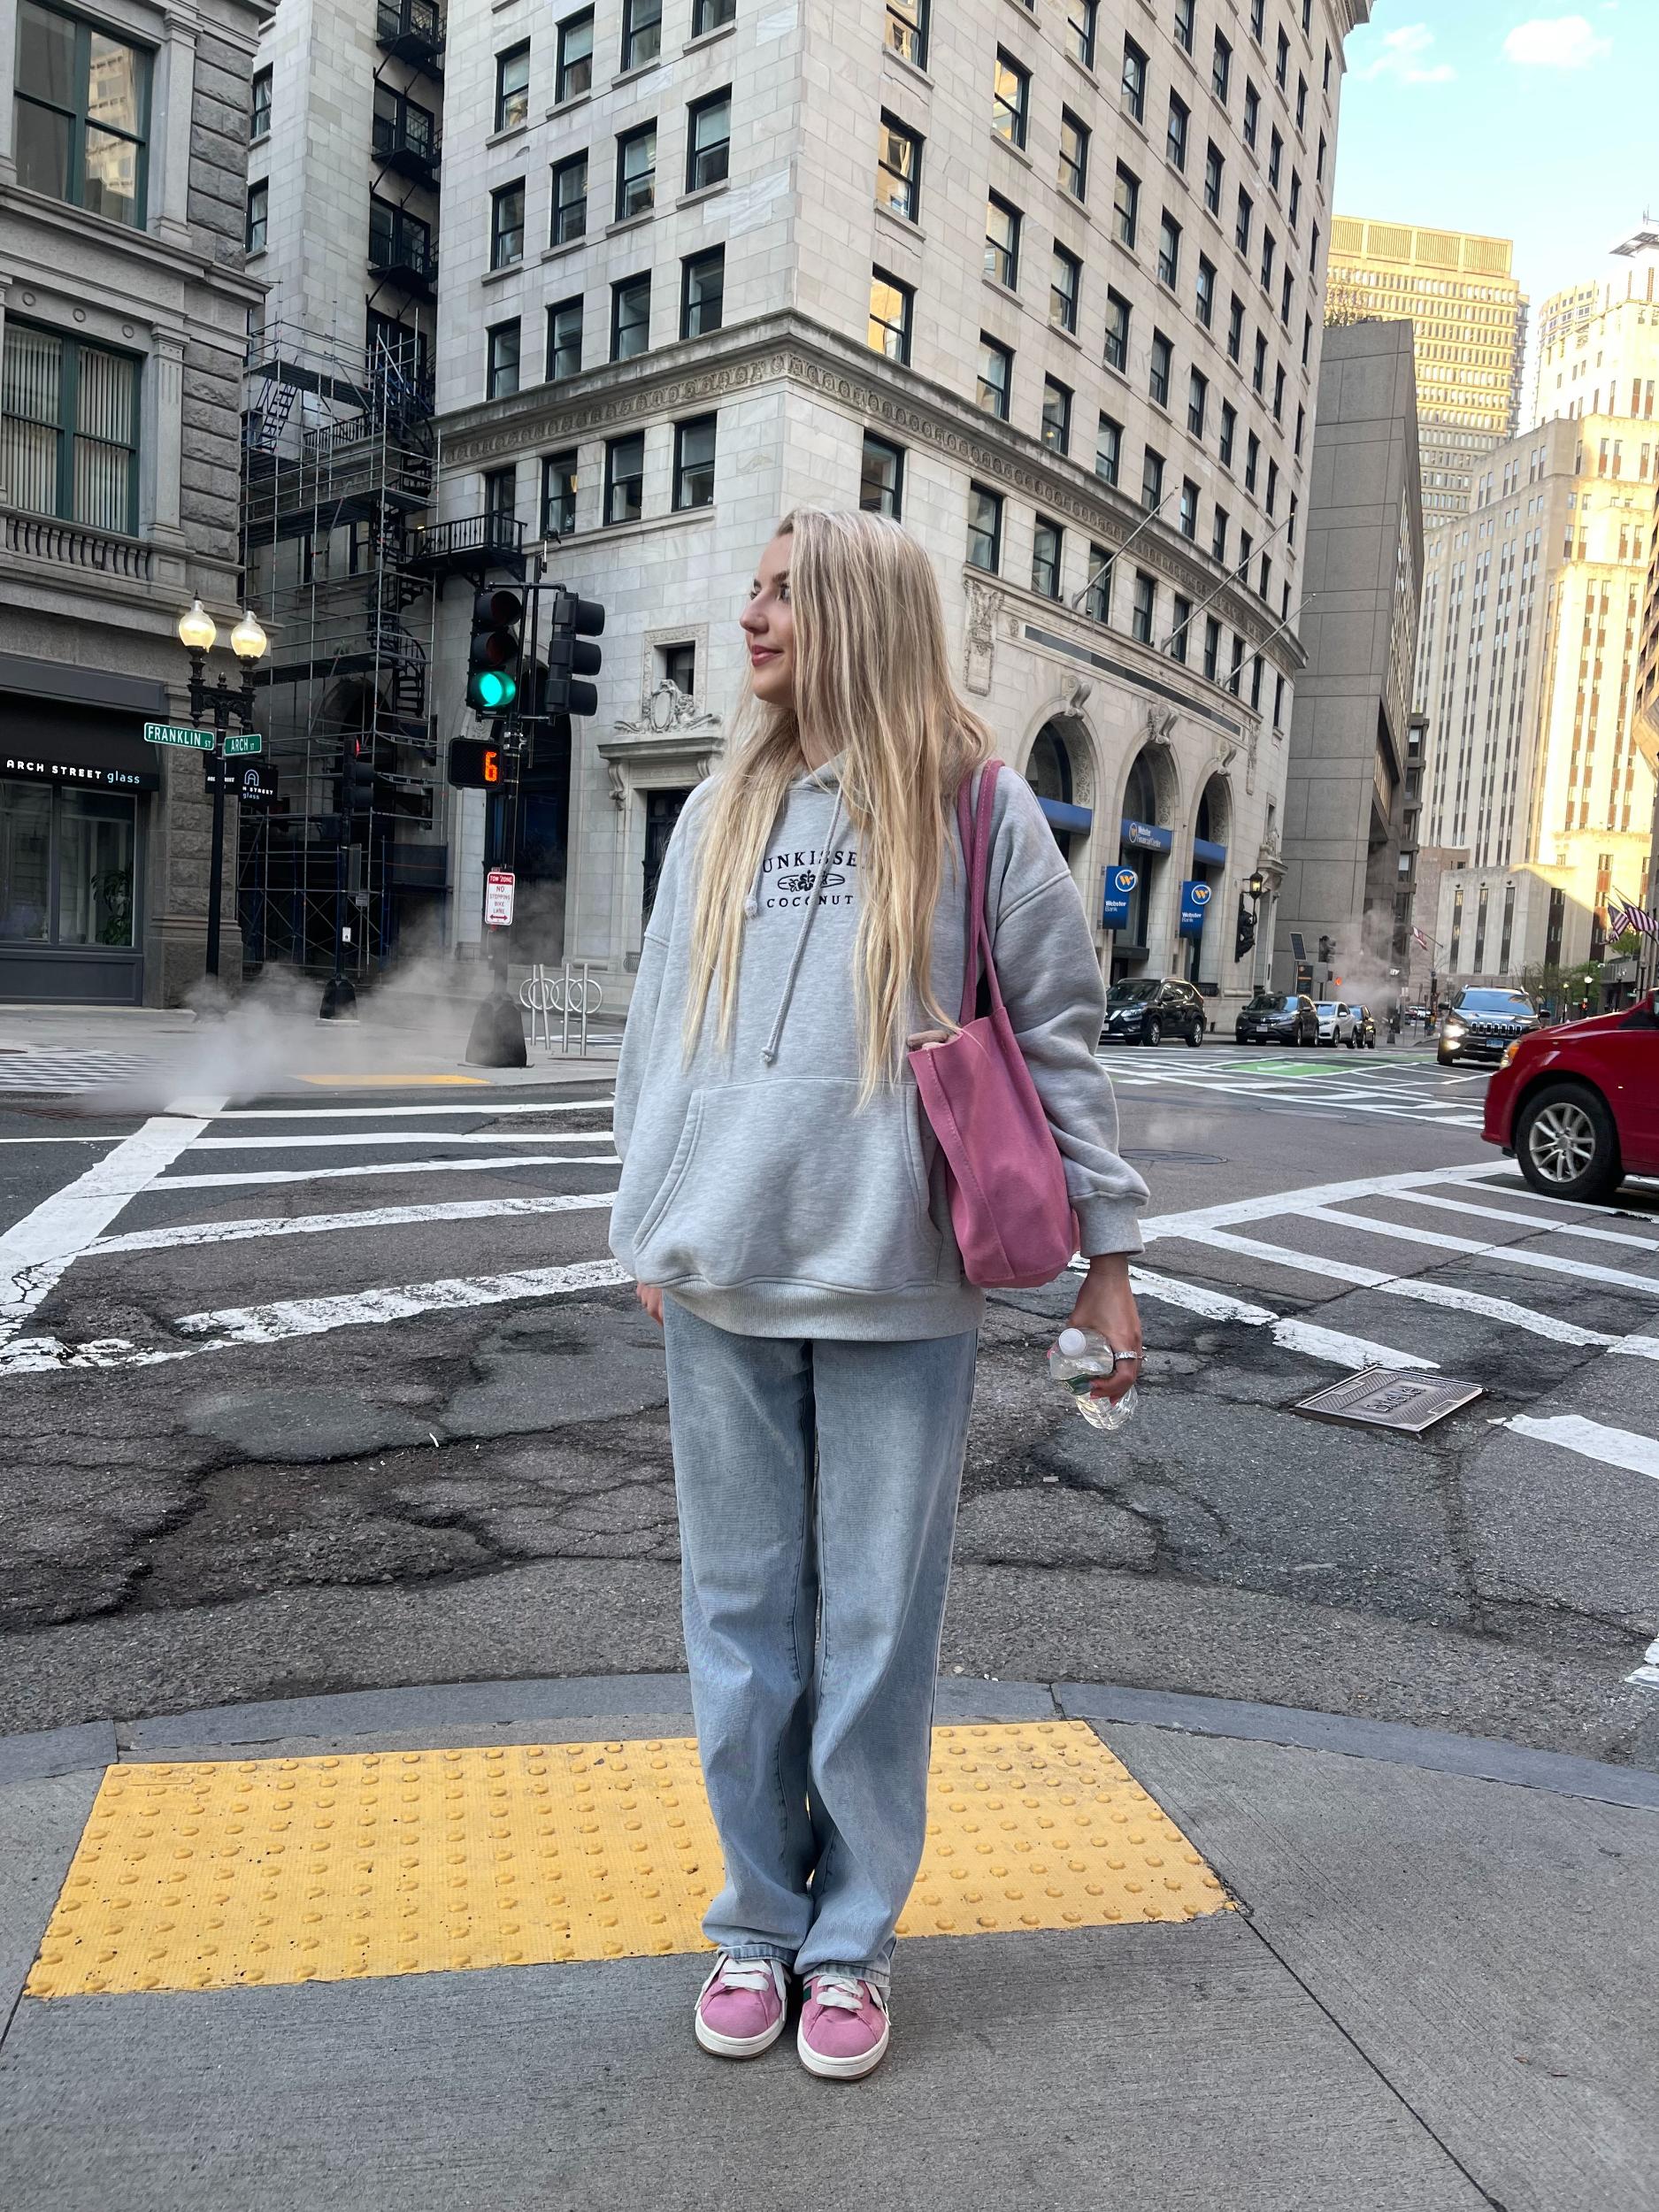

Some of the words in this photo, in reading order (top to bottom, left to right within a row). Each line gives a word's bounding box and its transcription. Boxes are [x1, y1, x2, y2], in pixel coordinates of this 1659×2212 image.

[148, 726, 201, 747] FRANKLIN
[231, 738, 249, 752] ARCH
[6, 759, 44, 772] ARCH
[51, 765, 102, 780] STREET
[107, 771, 140, 784] glass
[485, 751, 498, 782] 6
[763, 850, 857, 873] UNKISSE
